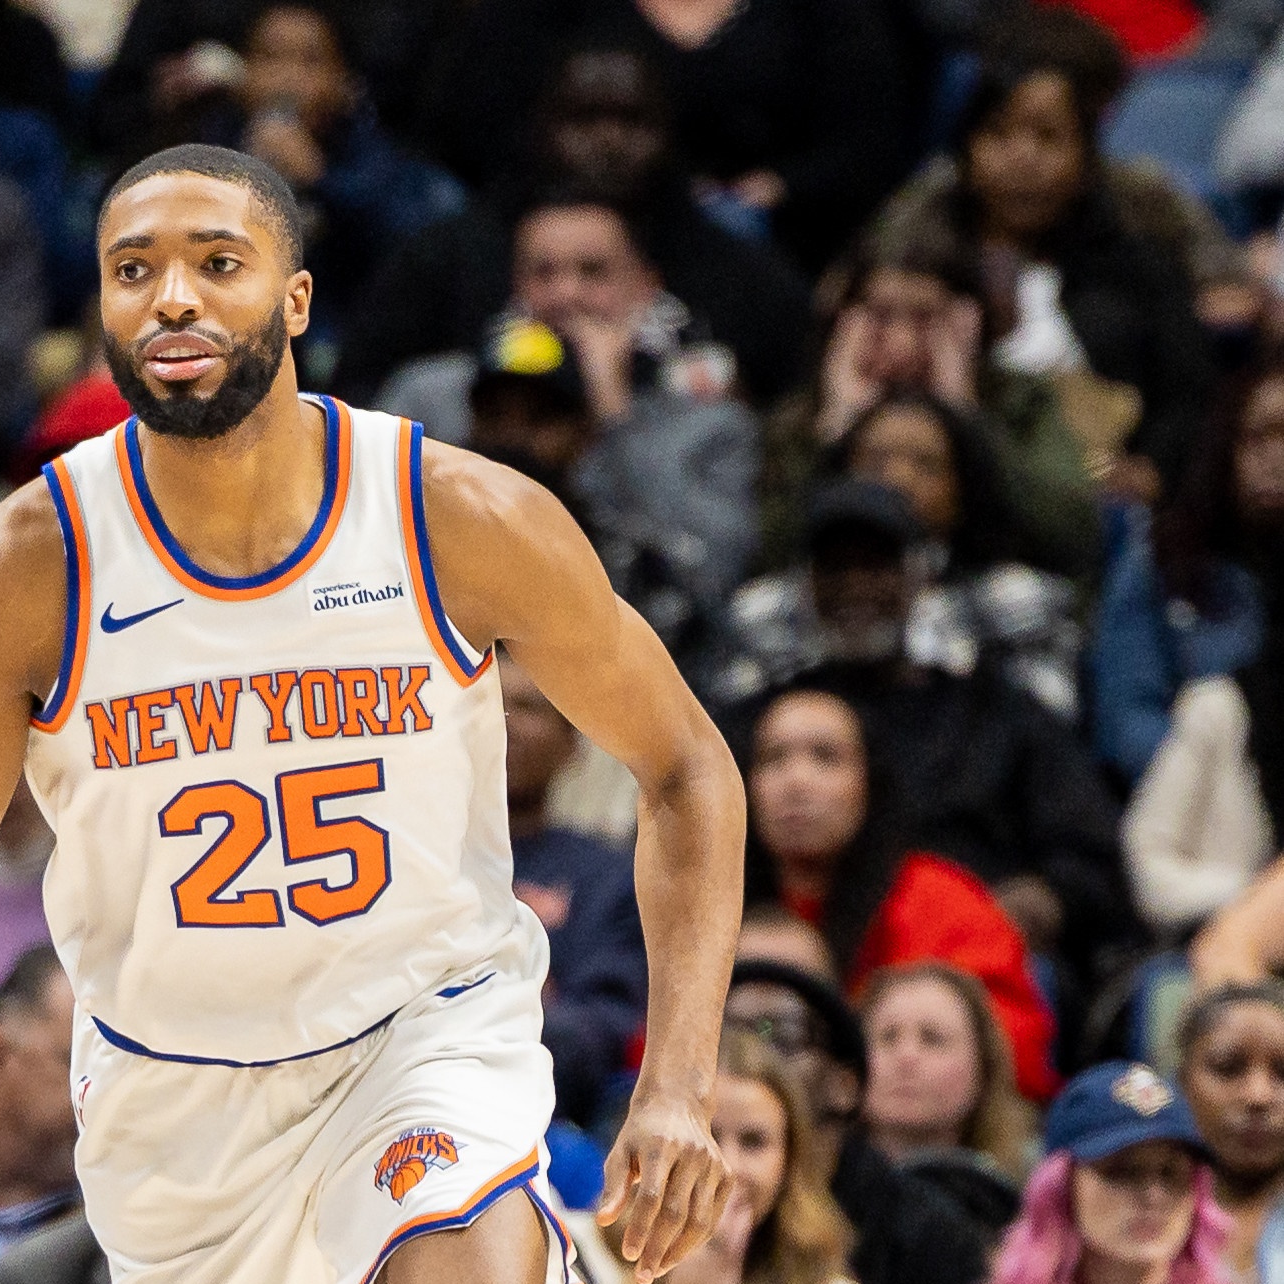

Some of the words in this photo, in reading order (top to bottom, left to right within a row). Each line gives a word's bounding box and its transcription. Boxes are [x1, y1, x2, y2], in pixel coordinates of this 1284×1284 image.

[313, 582, 361, 595] experience
[314, 595, 349, 611] abu
[84, 677, 243, 769] NEW
[250, 665, 433, 743] YORK
[158, 758, 392, 928] 25
